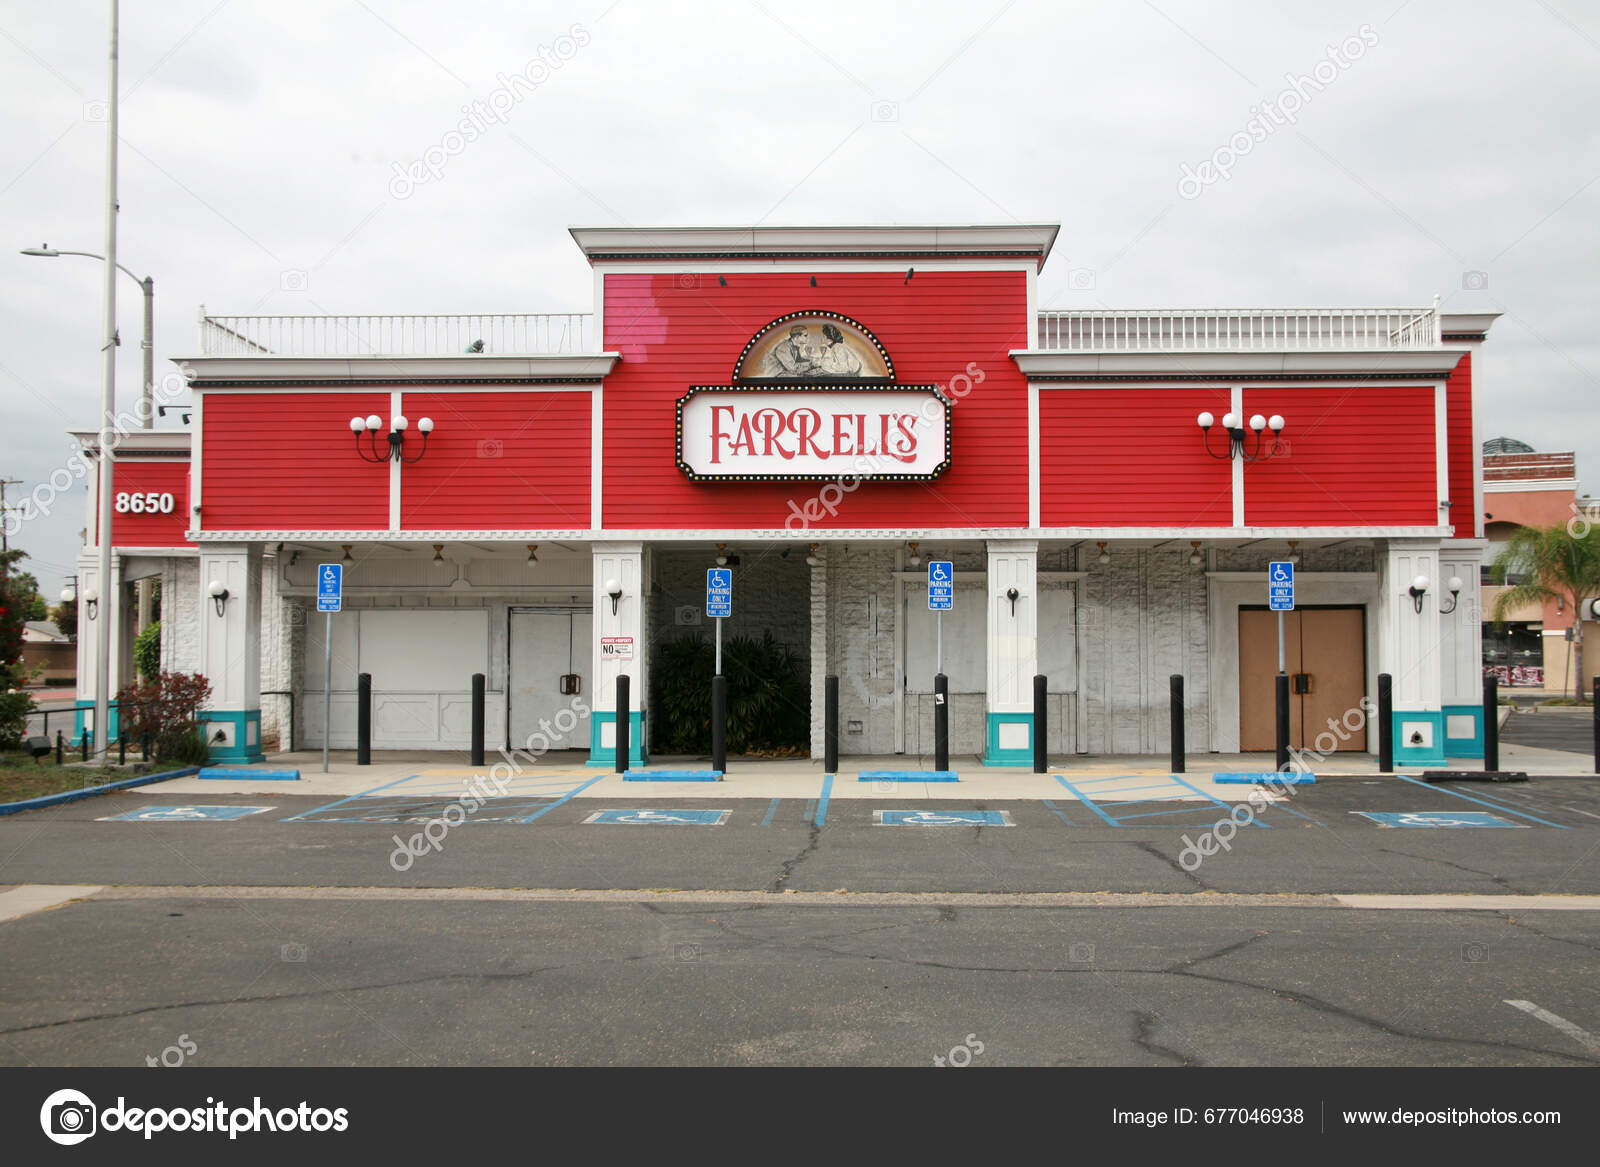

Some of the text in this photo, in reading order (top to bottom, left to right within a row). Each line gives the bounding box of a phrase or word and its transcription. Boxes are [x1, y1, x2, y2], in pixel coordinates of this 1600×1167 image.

[115, 492, 175, 514] 8650
[929, 580, 951, 588] PARKING
[1271, 580, 1292, 588] PARKING
[708, 587, 730, 595] PARKING
[1275, 588, 1288, 596] ONLY
[712, 595, 726, 603] ONLY
[602, 644, 614, 655] NO
